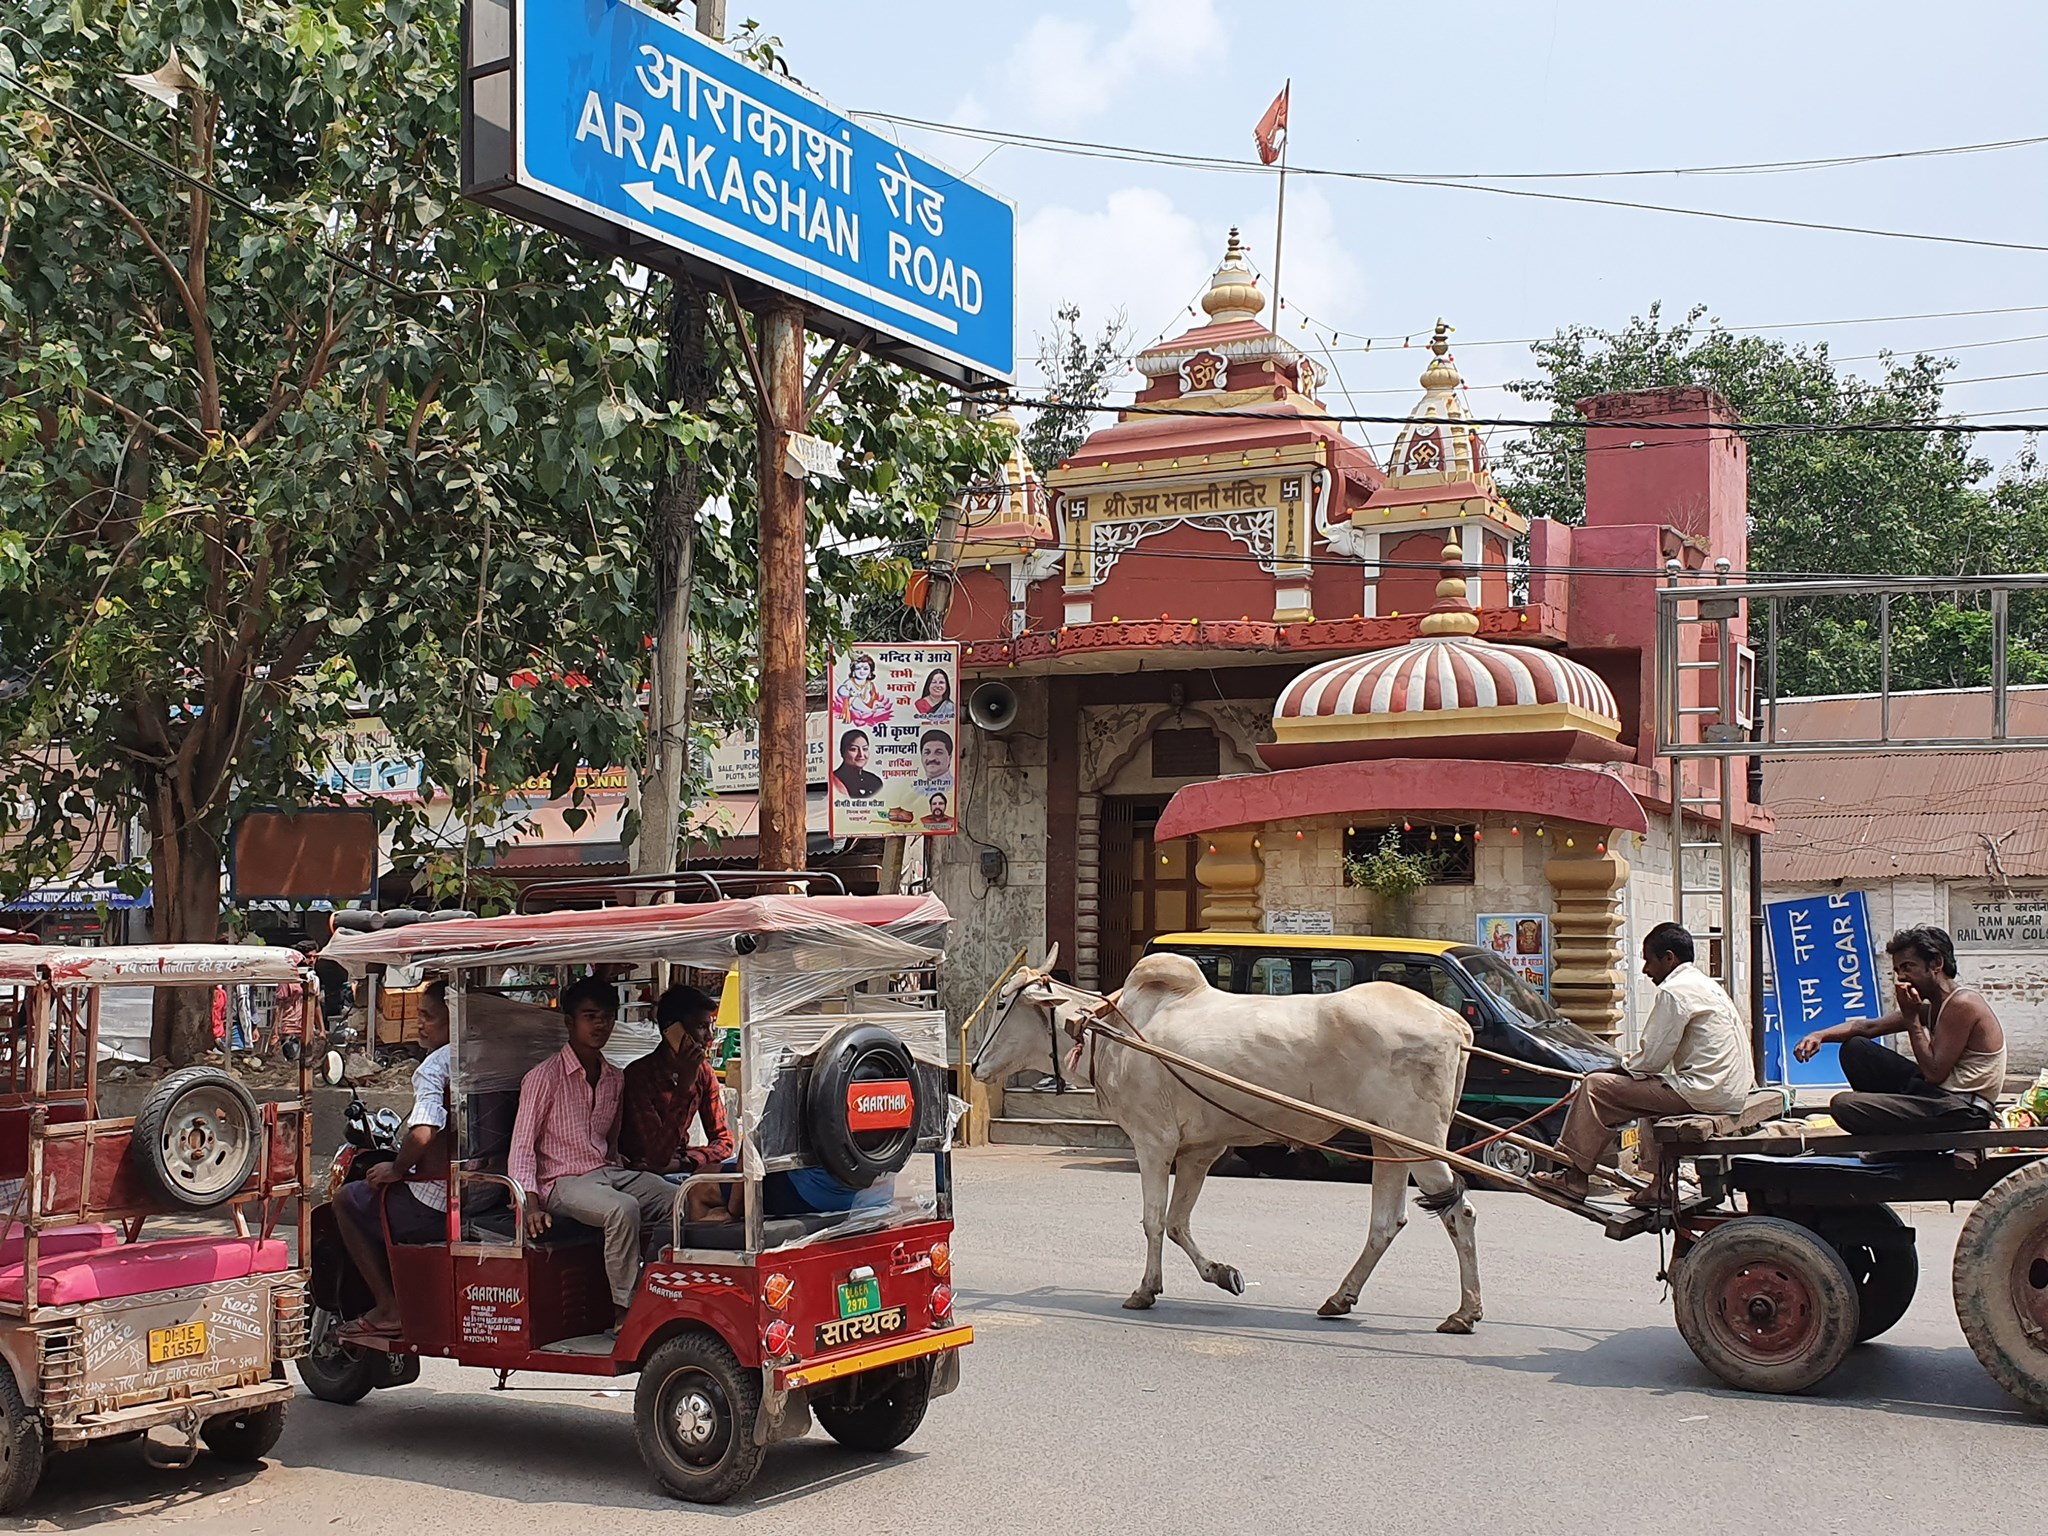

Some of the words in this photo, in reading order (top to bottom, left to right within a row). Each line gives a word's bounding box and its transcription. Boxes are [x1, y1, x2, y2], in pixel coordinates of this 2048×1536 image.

[575, 90, 859, 263] ARAKASHAN
[888, 230, 983, 316] ROAD
[876, 152, 945, 237] रोड
[1162, 482, 1220, 513] भवानी
[879, 650, 911, 662] मन्दिर
[914, 650, 925, 662] में
[927, 650, 952, 662] आये
[889, 668, 913, 678] सभी
[896, 695, 911, 705] को
[872, 723, 888, 738] श्री
[890, 726, 920, 741] कृष्ण
[875, 742, 918, 754] जन्माष्टमी
[1978, 916, 2003, 927] RAM
[2007, 915, 2042, 926] NAGAR
[1788, 909, 1815, 965] नगर
[1957, 928, 2014, 941] RAILWAY
[1832, 914, 1866, 1010] NAGAR
[1798, 978, 1823, 1022] राम
[857, 1094, 907, 1113] SAARTHAK
[466, 1285, 521, 1304] SAARTHAK
[649, 1283, 683, 1298] SAARTHAK
[847, 1297, 868, 1313] 2970
